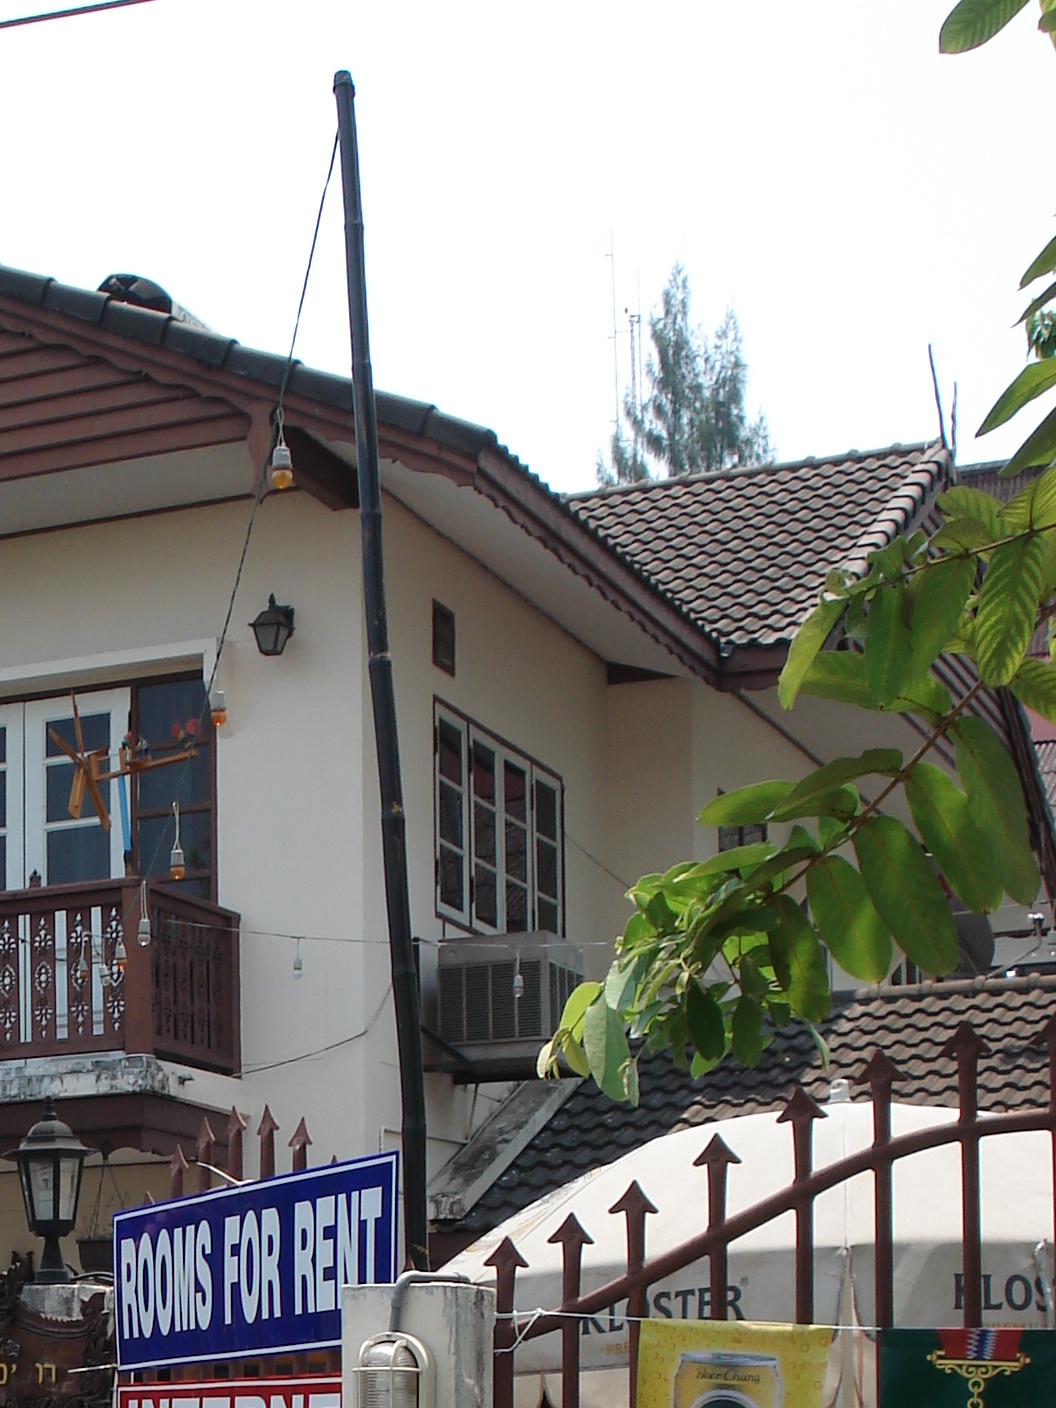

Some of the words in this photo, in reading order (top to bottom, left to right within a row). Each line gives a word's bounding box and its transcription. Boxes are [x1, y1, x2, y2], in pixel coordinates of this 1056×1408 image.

[120, 1218, 213, 1340] ROOMS
[223, 1206, 283, 1326] FOR
[293, 1186, 384, 1316] RENT
[696, 1367, 721, 1380] Beer
